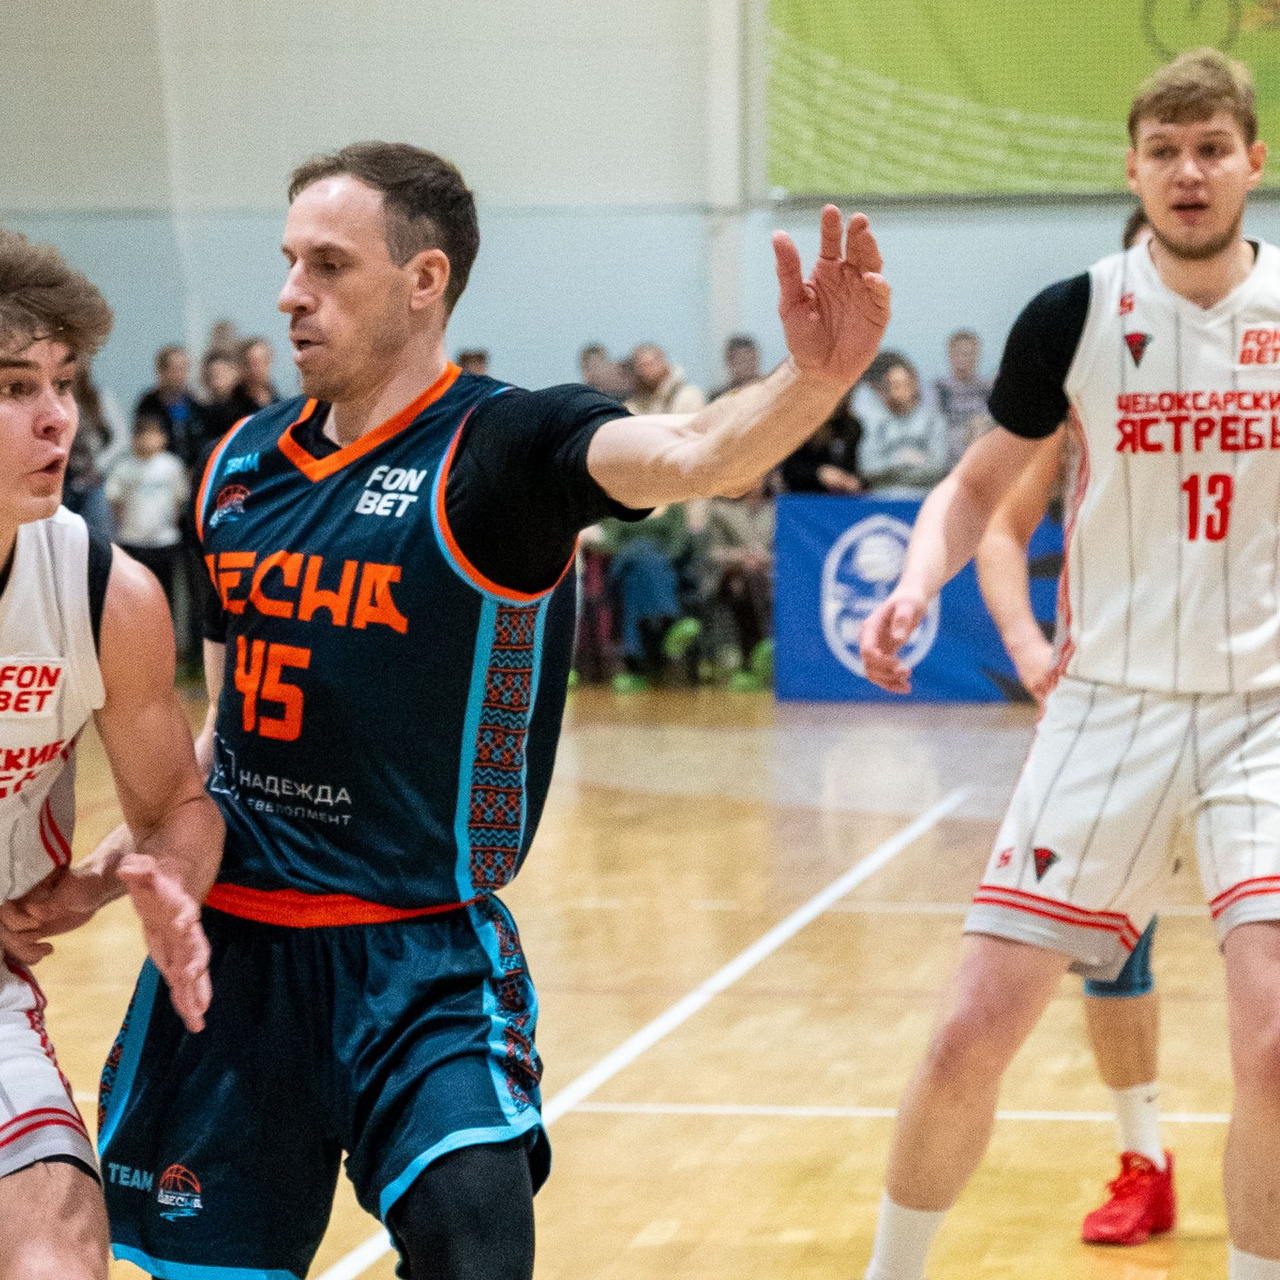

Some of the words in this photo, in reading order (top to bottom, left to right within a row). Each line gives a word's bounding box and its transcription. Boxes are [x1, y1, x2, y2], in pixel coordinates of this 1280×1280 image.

[365, 465, 427, 492] FON
[355, 490, 418, 517] BET
[1181, 473, 1234, 541] 13
[234, 634, 311, 742] 45
[239, 770, 352, 807] НАДЕЖДА
[108, 1162, 154, 1192] TEAM
